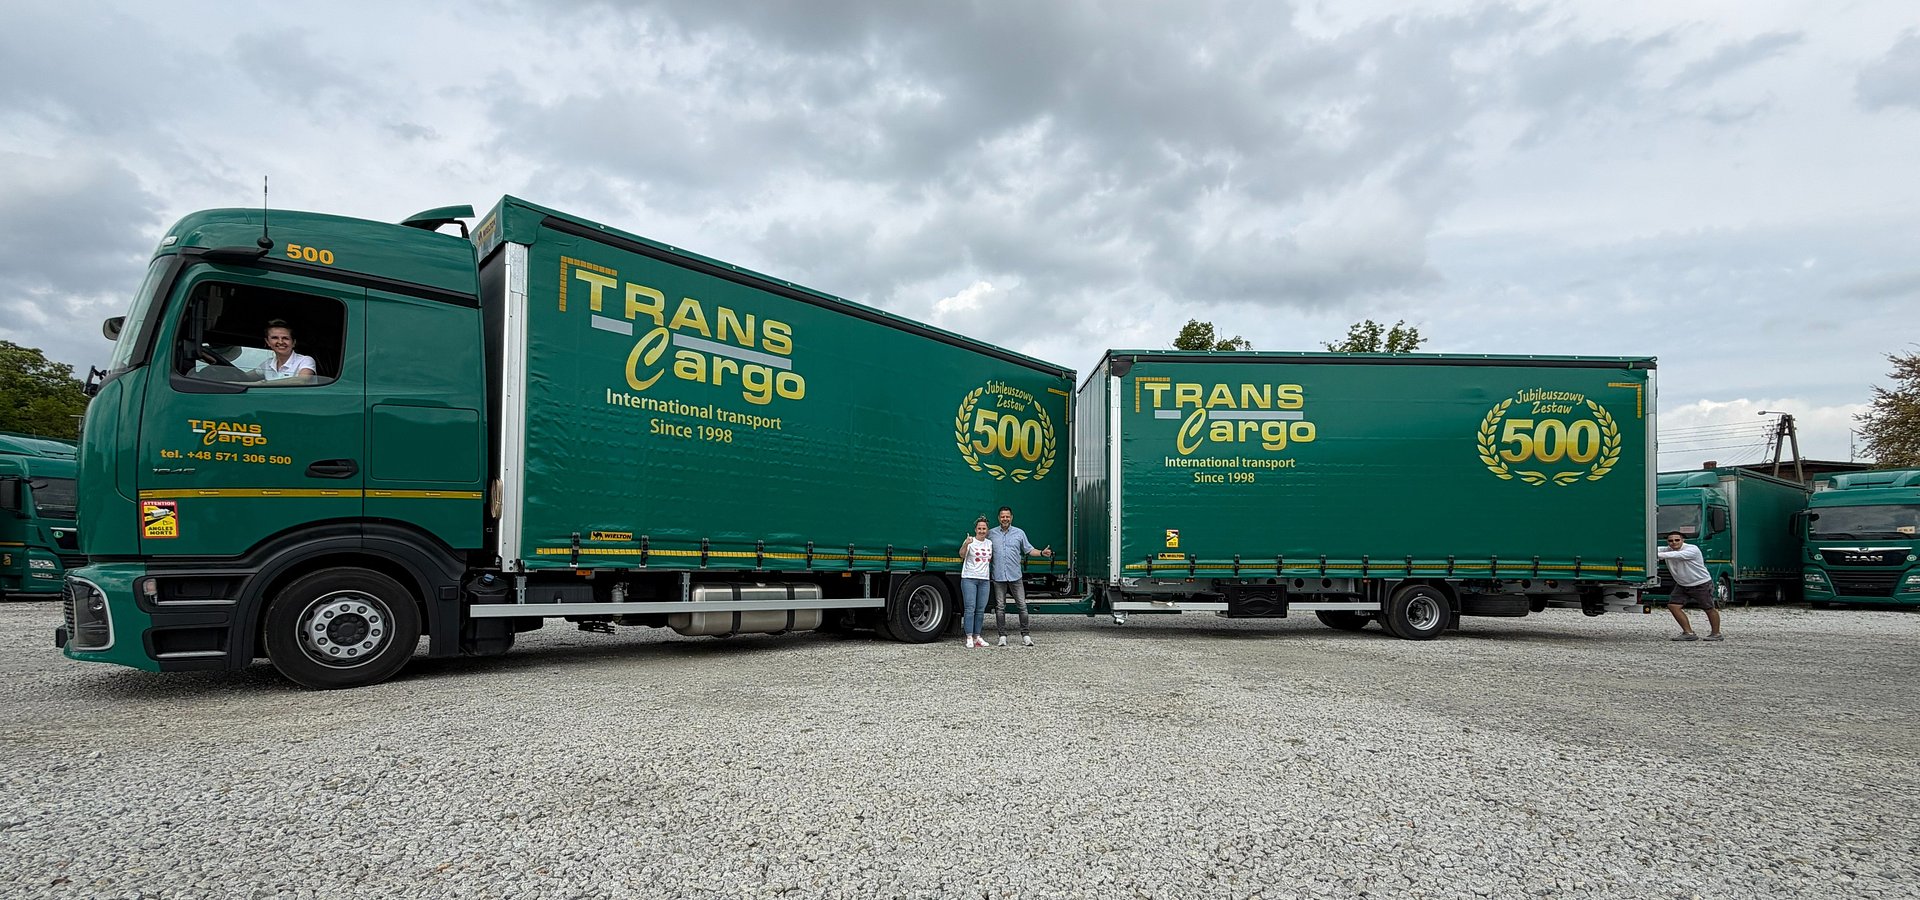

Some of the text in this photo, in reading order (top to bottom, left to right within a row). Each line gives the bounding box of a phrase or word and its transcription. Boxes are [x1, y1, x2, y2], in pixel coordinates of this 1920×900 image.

[287, 243, 334, 265] 500
[575, 268, 792, 355] TRANS
[625, 326, 805, 405] Cargo
[985, 380, 1034, 405] Jubileuszowy
[997, 395, 1025, 412] Zestaw
[1144, 383, 1304, 409] TRANS
[1515, 388, 1585, 405] Jubileuszowy
[606, 388, 781, 430] International transport
[1531, 400, 1572, 415] Zestaw
[187, 419, 262, 434] TRANS
[650, 418, 733, 443] Since 1998
[972, 408, 1043, 462] 500
[1177, 408, 1316, 455] Cargo
[203, 430, 268, 447] Cargo
[1499, 418, 1601, 463] 500
[160, 449, 292, 465] tel. +48 571 306 500
[1165, 456, 1296, 470] International transport
[1193, 472, 1255, 483] Since 1998
